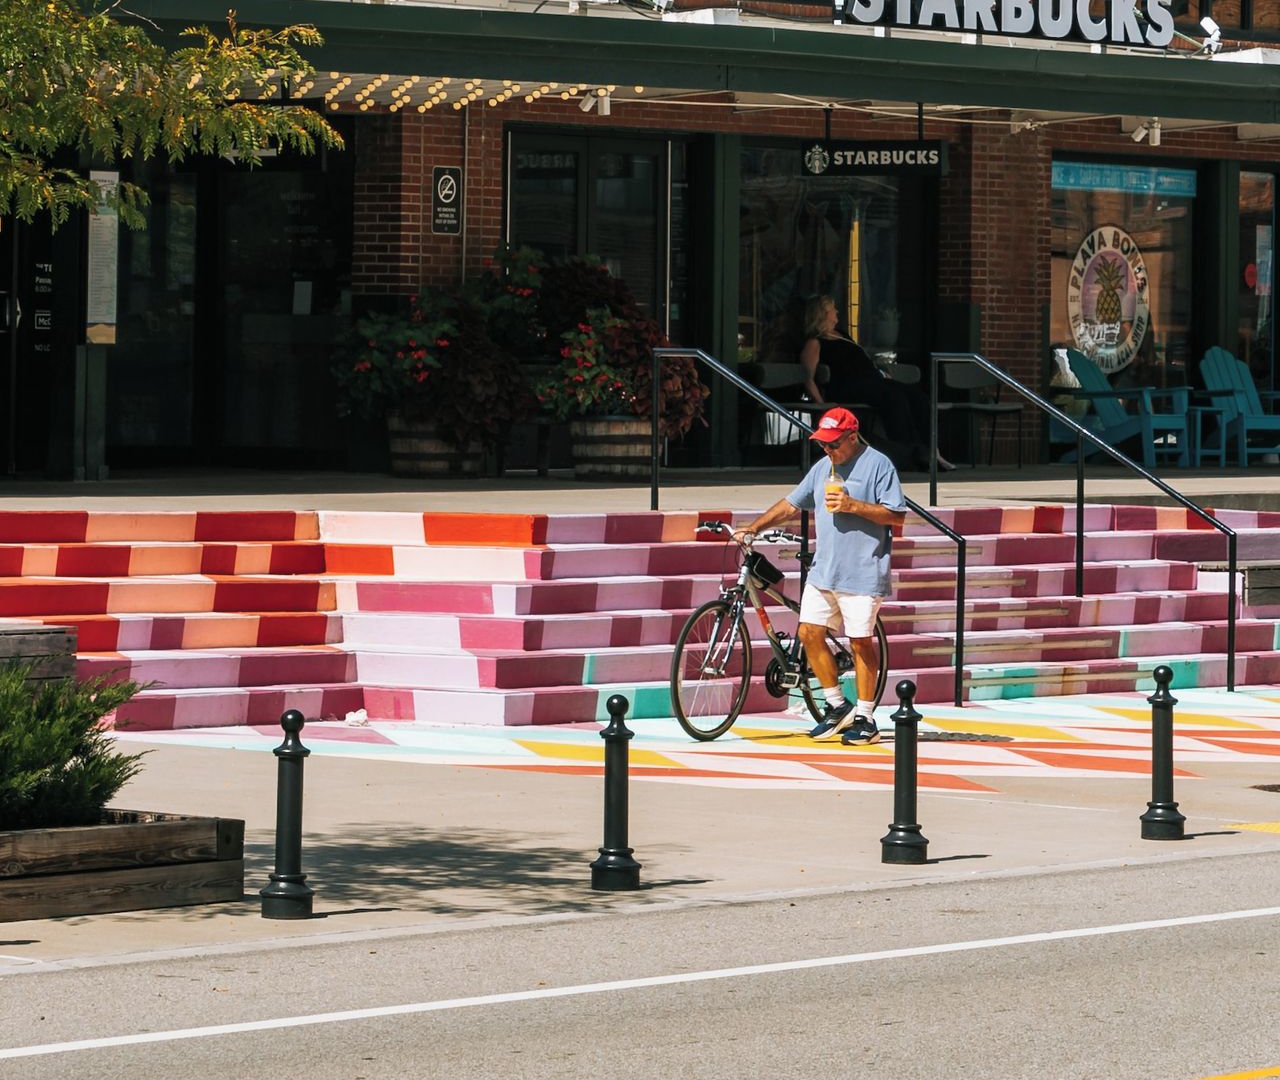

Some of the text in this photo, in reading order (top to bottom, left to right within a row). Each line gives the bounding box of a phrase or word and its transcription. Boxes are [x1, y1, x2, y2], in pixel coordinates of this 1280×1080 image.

[833, 150, 939, 165] STARBUCKS
[1071, 231, 1107, 292] PLAYA
[1131, 316, 1146, 347] SHOP
